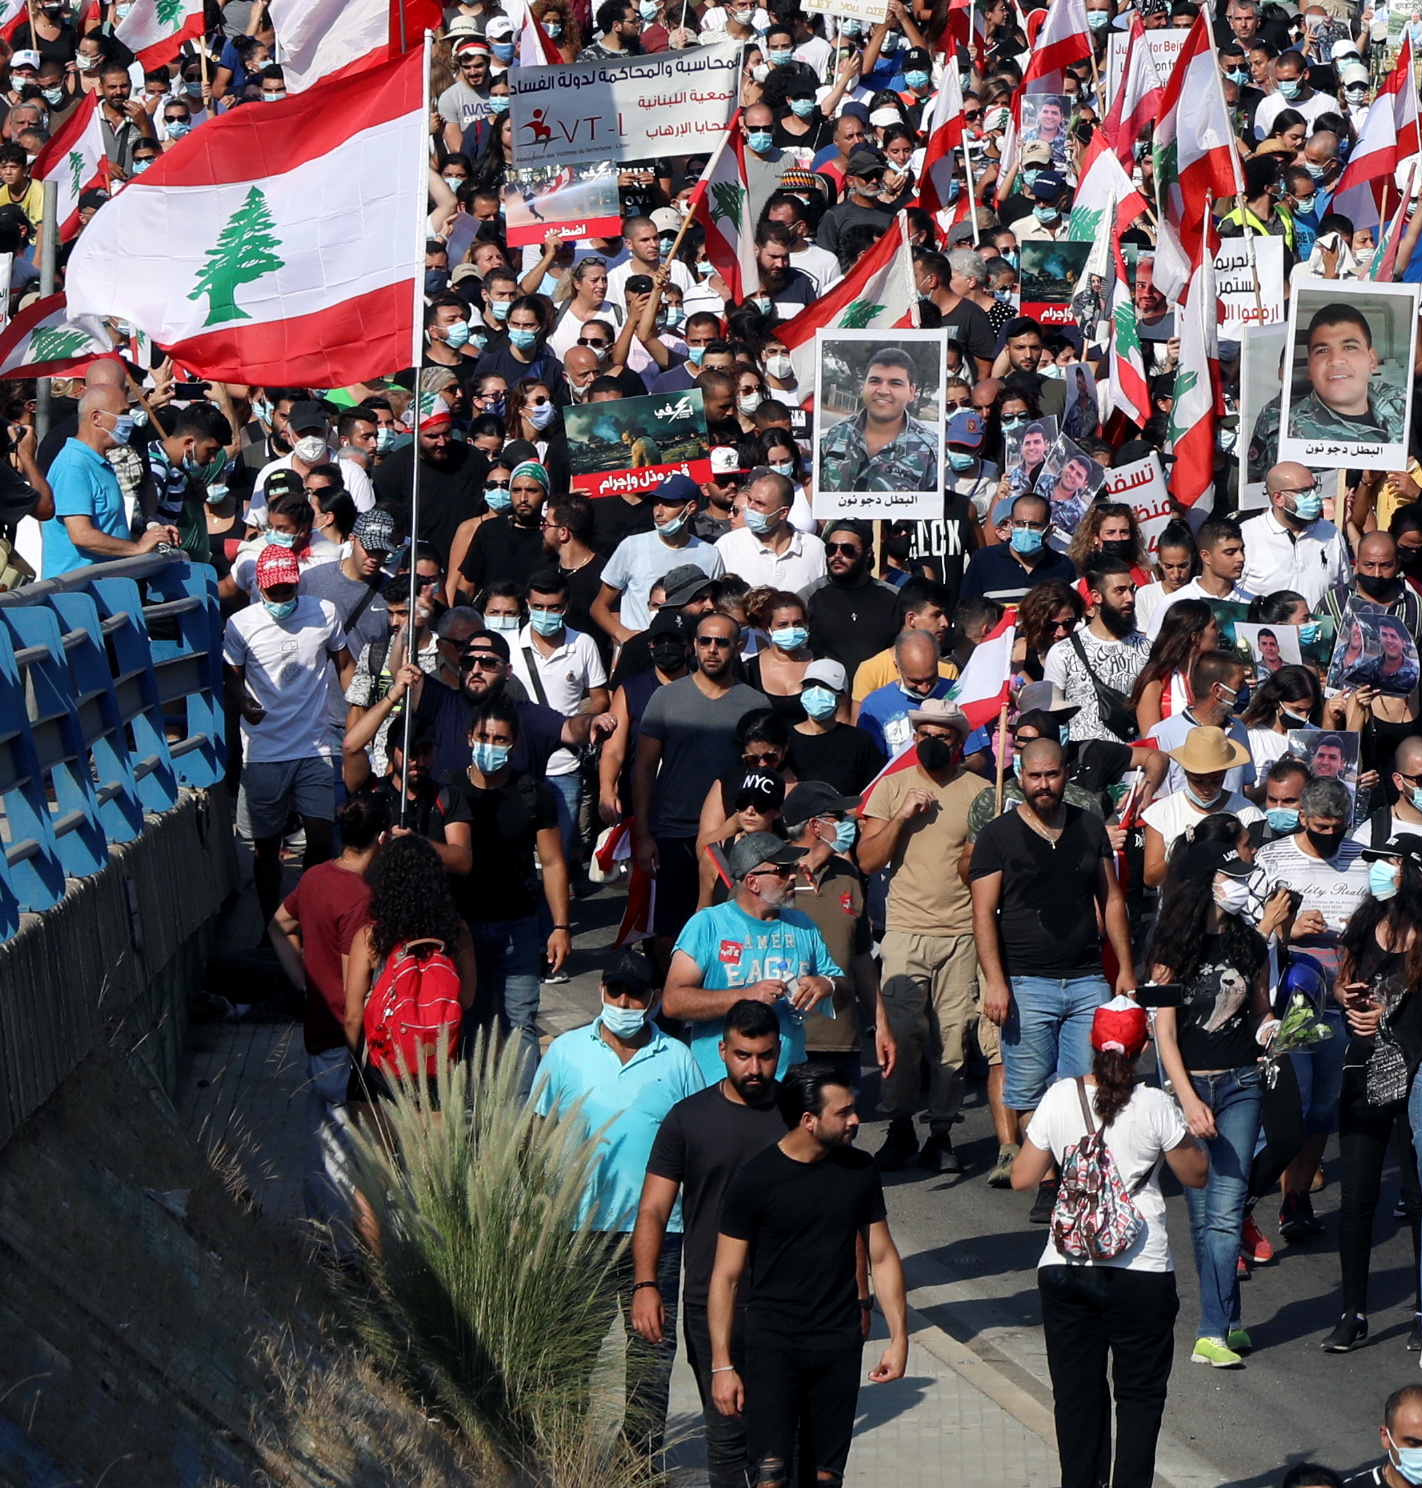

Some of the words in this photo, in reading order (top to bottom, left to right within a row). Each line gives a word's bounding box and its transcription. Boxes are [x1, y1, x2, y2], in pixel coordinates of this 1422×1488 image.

[835, 0, 860, 13] YOU
[865, 6, 885, 17] DIE
[598, 61, 672, 83] والمحاكمة
[509, 75, 555, 97] الفساد
[557, 70, 596, 91] لدولة
[638, 92, 687, 110] اللبنانية
[645, 122, 691, 138] الإرهاب
[555, 149, 577, 158] Victimes
[1305, 444, 1324, 457] نون
[1325, 445, 1349, 457] دجو
[1350, 444, 1383, 457] البطل
[838, 495, 858, 507] نون
[860, 496, 882, 507] دجو
[885, 495, 918, 507] البطل
[743, 774, 774, 795] NYC
[743, 934, 796, 950] AMER
[724, 957, 810, 987] EAGE
